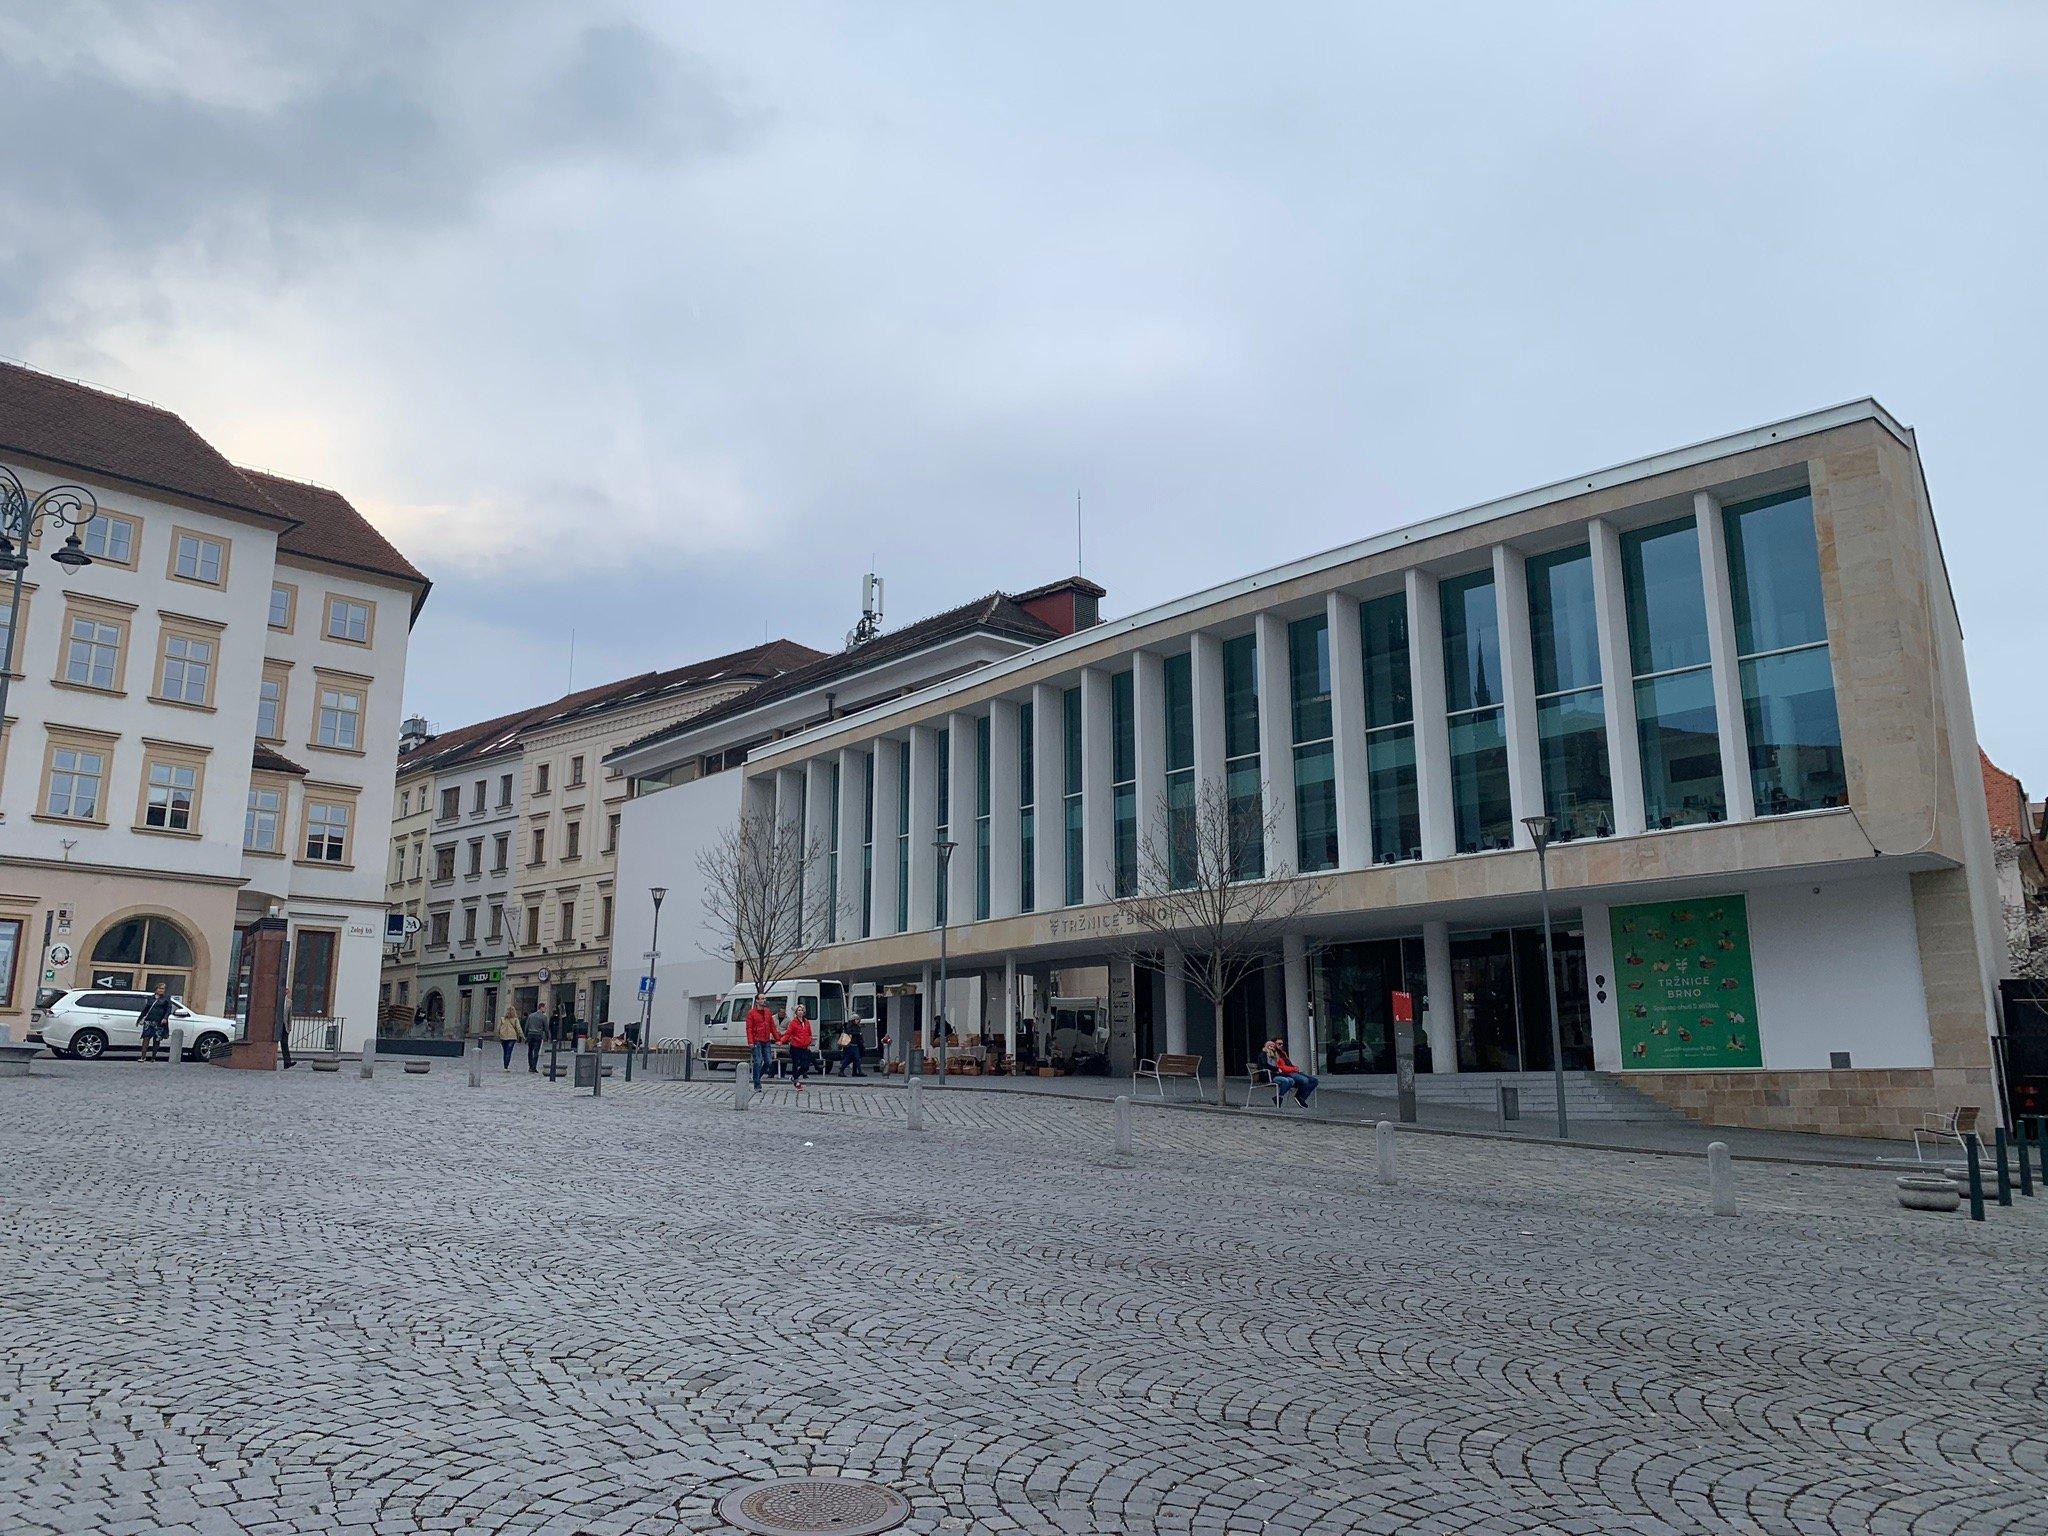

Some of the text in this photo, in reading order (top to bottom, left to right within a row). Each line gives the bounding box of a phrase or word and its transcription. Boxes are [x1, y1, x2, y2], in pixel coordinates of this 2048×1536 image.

[1061, 913, 1120, 933] TRŽNICE
[1658, 976, 1709, 987] TRŽNICE
[1667, 989, 1701, 999] BRNO
